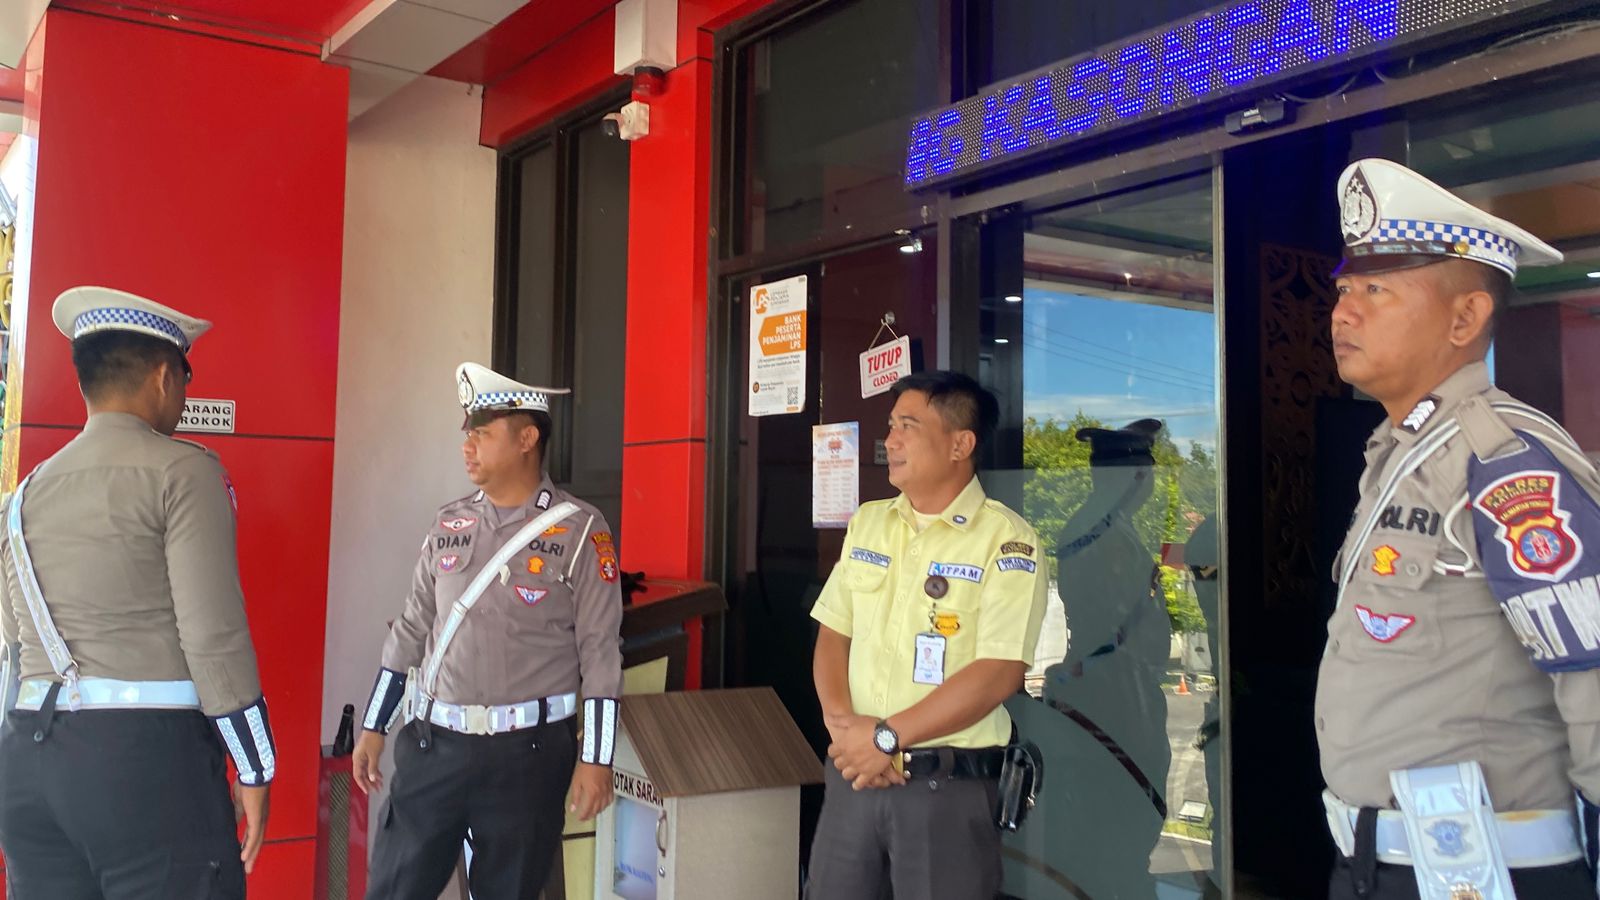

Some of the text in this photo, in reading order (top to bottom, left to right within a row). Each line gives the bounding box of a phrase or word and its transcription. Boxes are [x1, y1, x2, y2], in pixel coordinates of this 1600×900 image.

[981, 0, 1399, 160] KASONGAN
[784, 314, 801, 325] BANK
[776, 322, 801, 335] PESERTA
[790, 341, 801, 350] LPS
[867, 346, 902, 374] TUTUP
[873, 371, 898, 388] CLOSED
[184, 404, 231, 416] ARANG
[180, 416, 231, 427] ROKOK
[1484, 477, 1549, 507] POLRES
[1377, 505, 1440, 536] OLRI
[437, 534, 472, 550] DIAN
[528, 539, 565, 557] OLRI
[614, 771, 635, 796] OTAK
